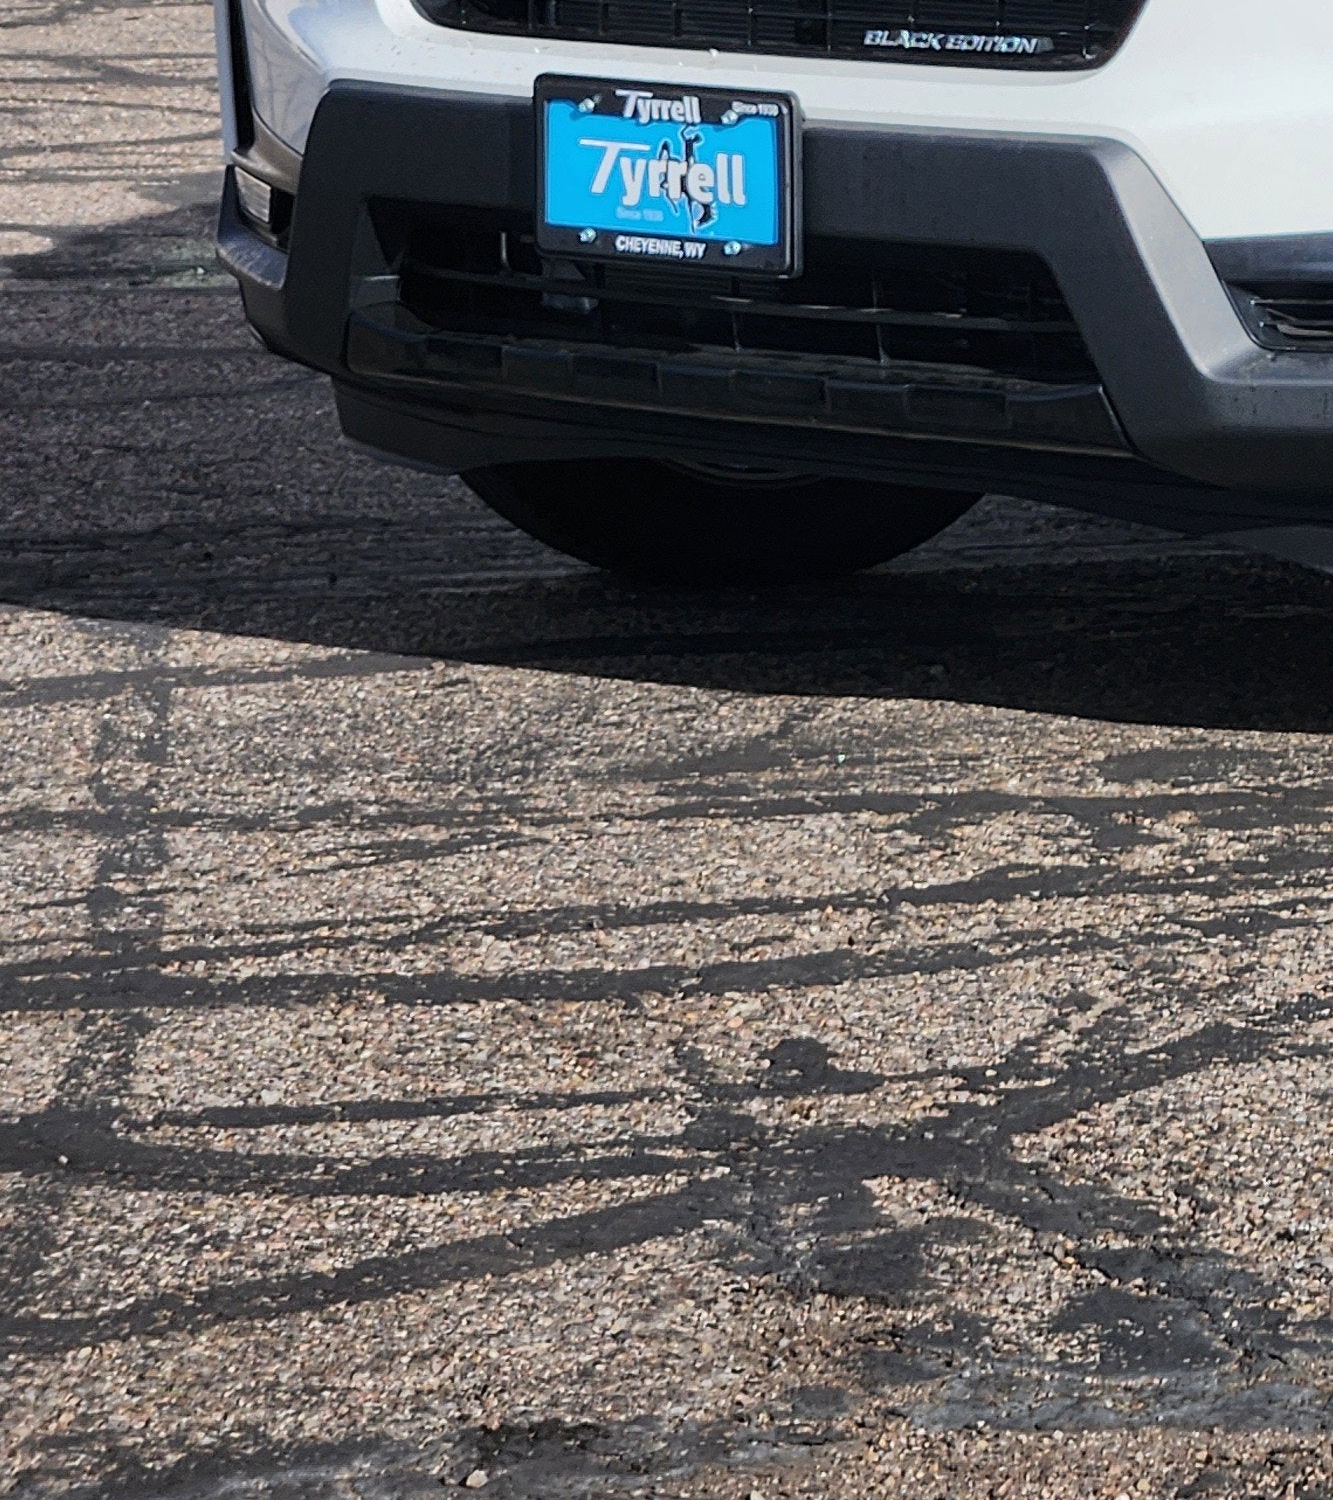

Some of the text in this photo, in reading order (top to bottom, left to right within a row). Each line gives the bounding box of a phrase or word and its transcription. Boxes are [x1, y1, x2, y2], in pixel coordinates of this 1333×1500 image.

[863, 29, 1039, 54] BLACK EDITION
[614, 89, 702, 125] Tyrrell
[578, 138, 747, 207] Tyrrell
[614, 234, 707, 260] CHEYENNE, WY
